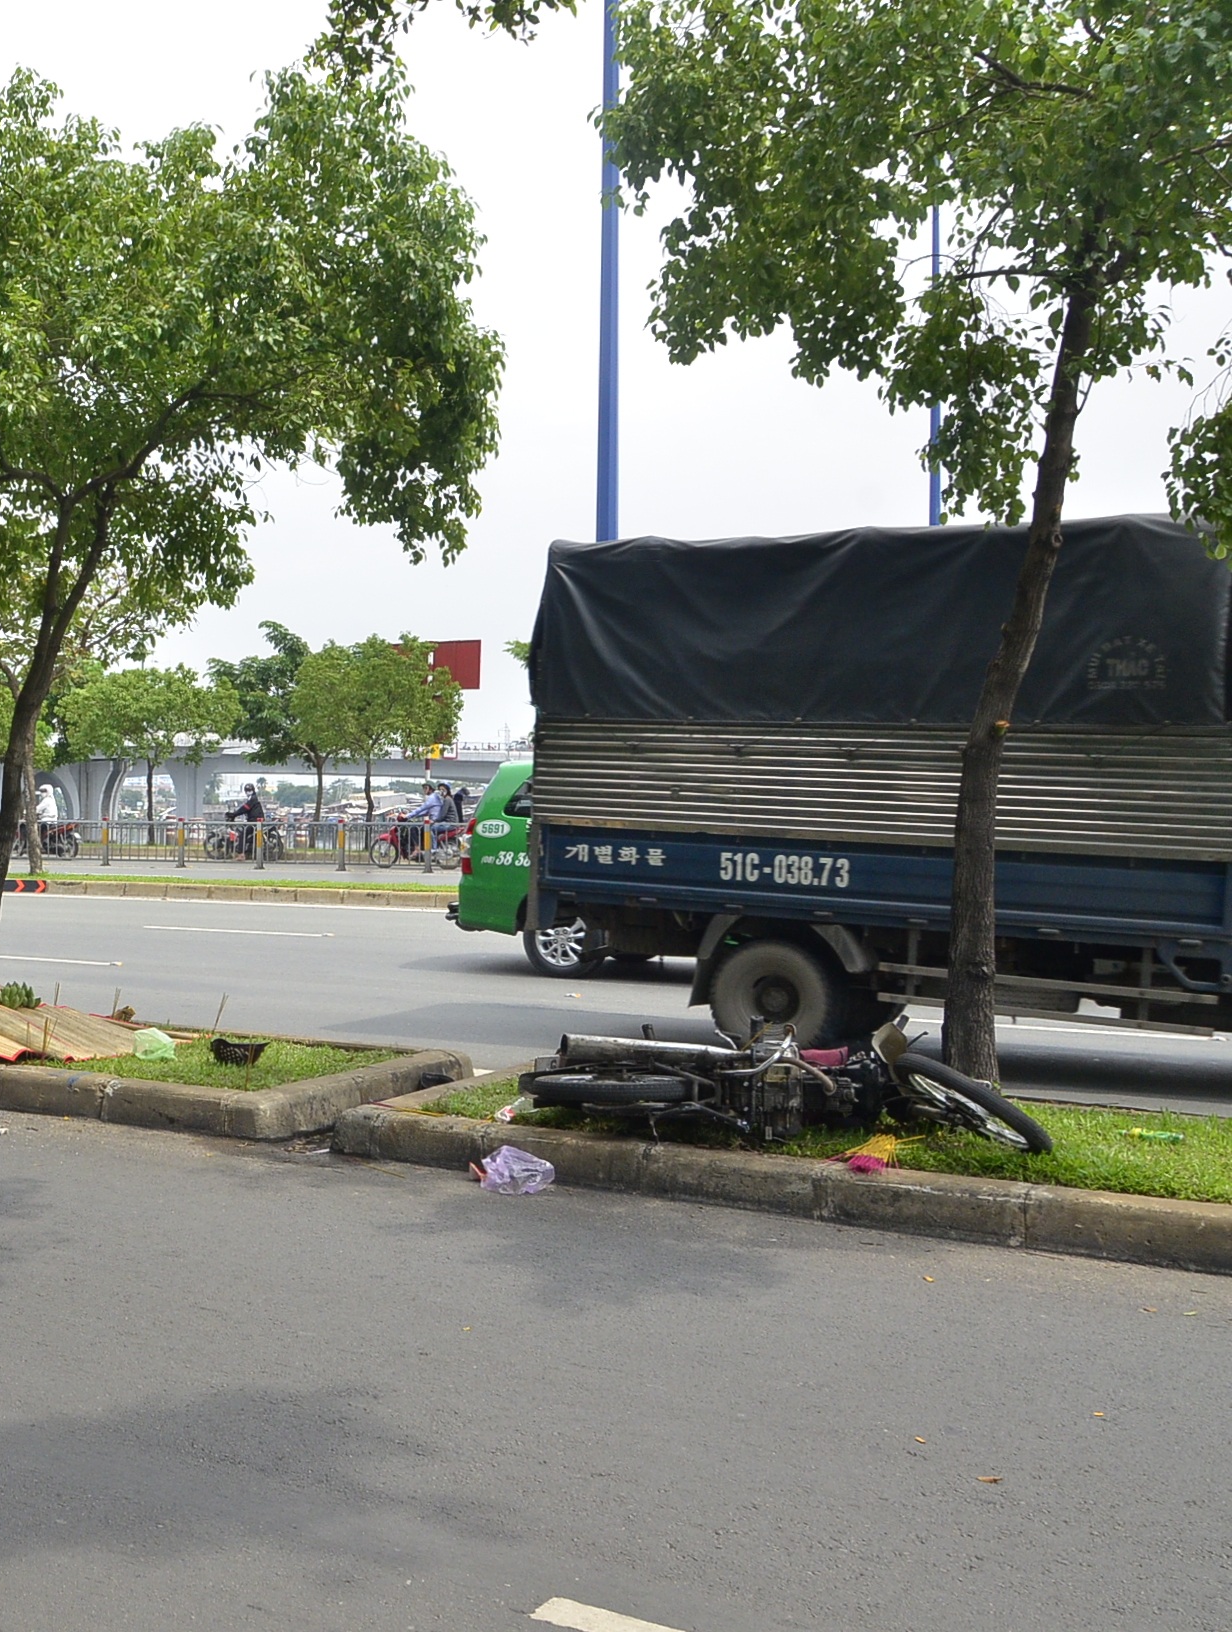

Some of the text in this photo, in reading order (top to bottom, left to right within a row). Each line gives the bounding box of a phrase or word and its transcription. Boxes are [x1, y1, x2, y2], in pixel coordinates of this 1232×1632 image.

[481, 823, 505, 834] 5691
[496, 850, 514, 866] 38
[719, 852, 850, 888] 51C-038.73
